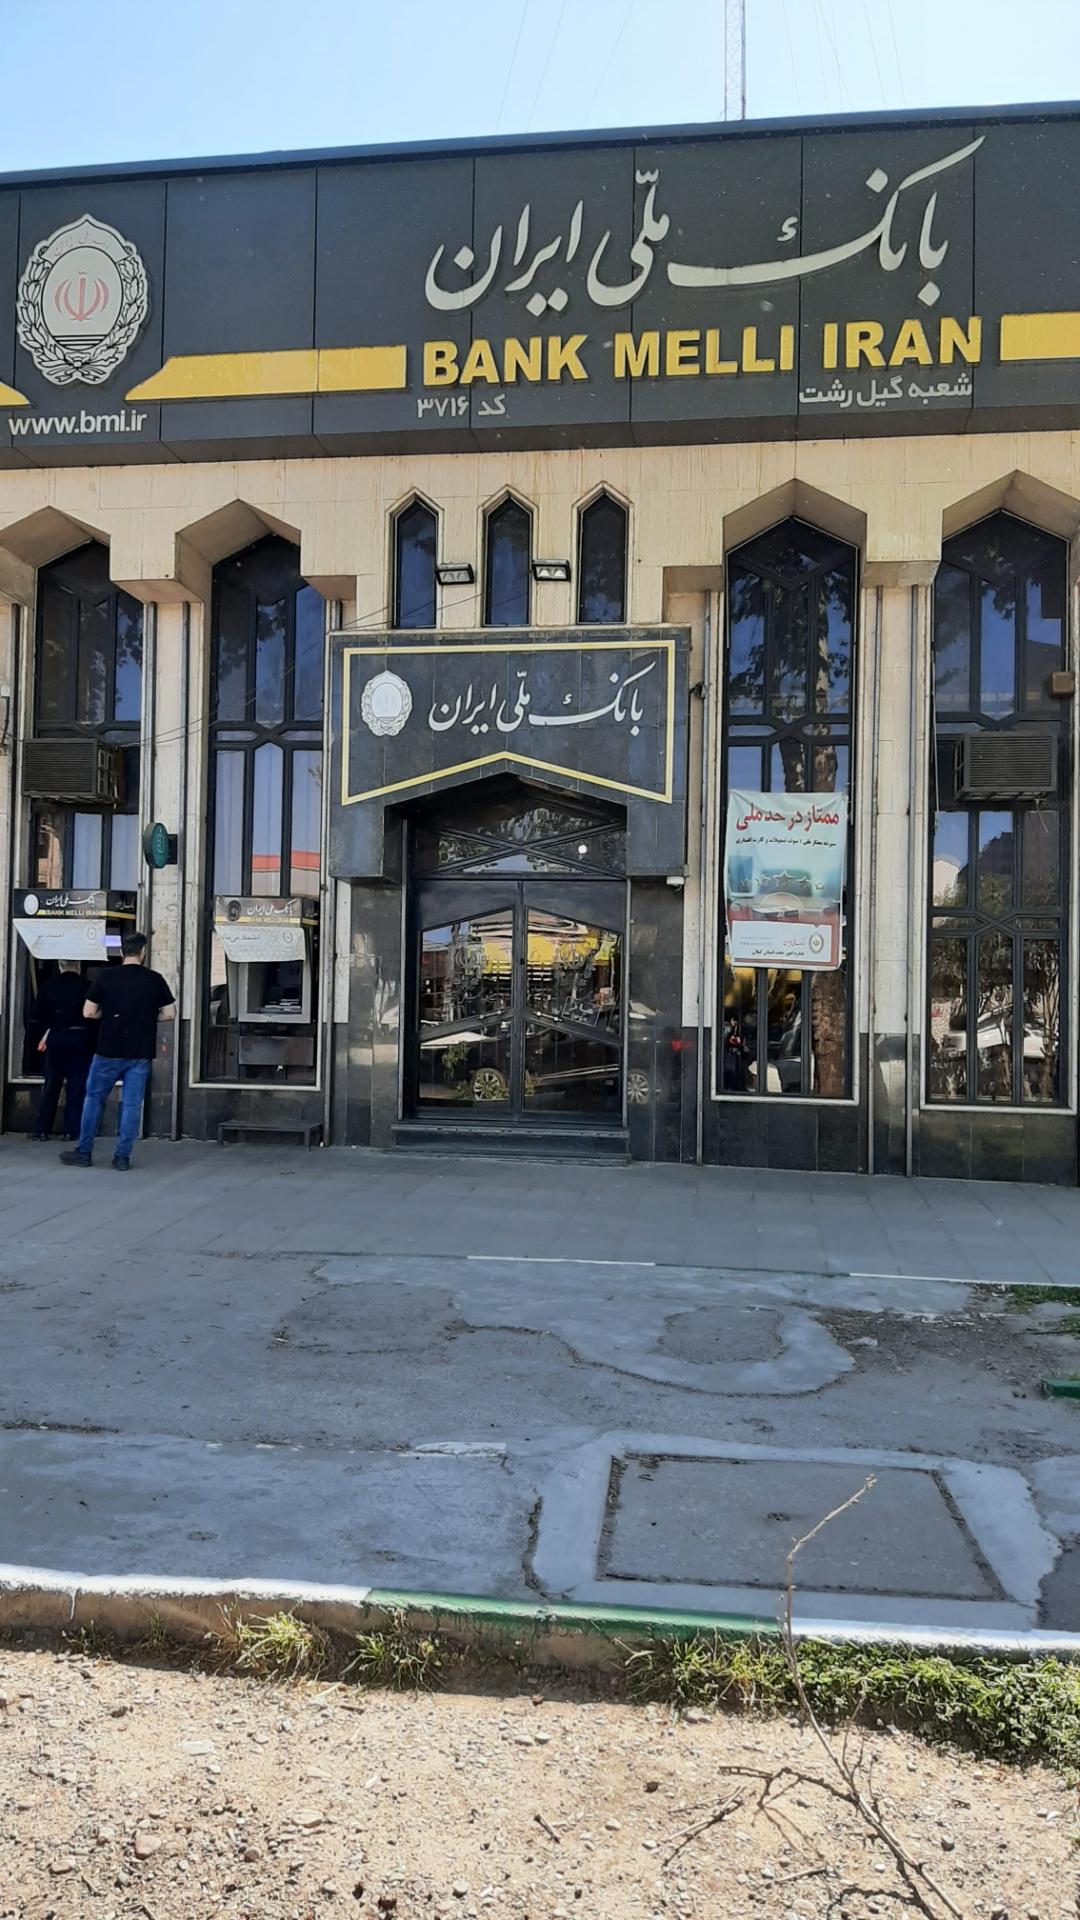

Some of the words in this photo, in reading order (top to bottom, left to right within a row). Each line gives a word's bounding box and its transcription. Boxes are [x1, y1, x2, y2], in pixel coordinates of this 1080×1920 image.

[425, 200, 583, 316] ایران
[423, 334, 589, 386] BANK
[613, 324, 794, 379] MELLI
[823, 316, 982, 369] IRAN
[799, 379, 853, 408] رشت
[857, 375, 904, 407] گیل
[908, 372, 973, 405] شعبه
[416, 395, 470, 418] ۳۷۱۶
[478, 394, 506, 416] کد
[8, 410, 147, 436] www.bmi.ir
[428, 682, 497, 735] ایران
[736, 802, 763, 831] ملی
[764, 810, 786, 821] حد
[787, 810, 803, 831] در
[804, 804, 839, 832] ممتاز
